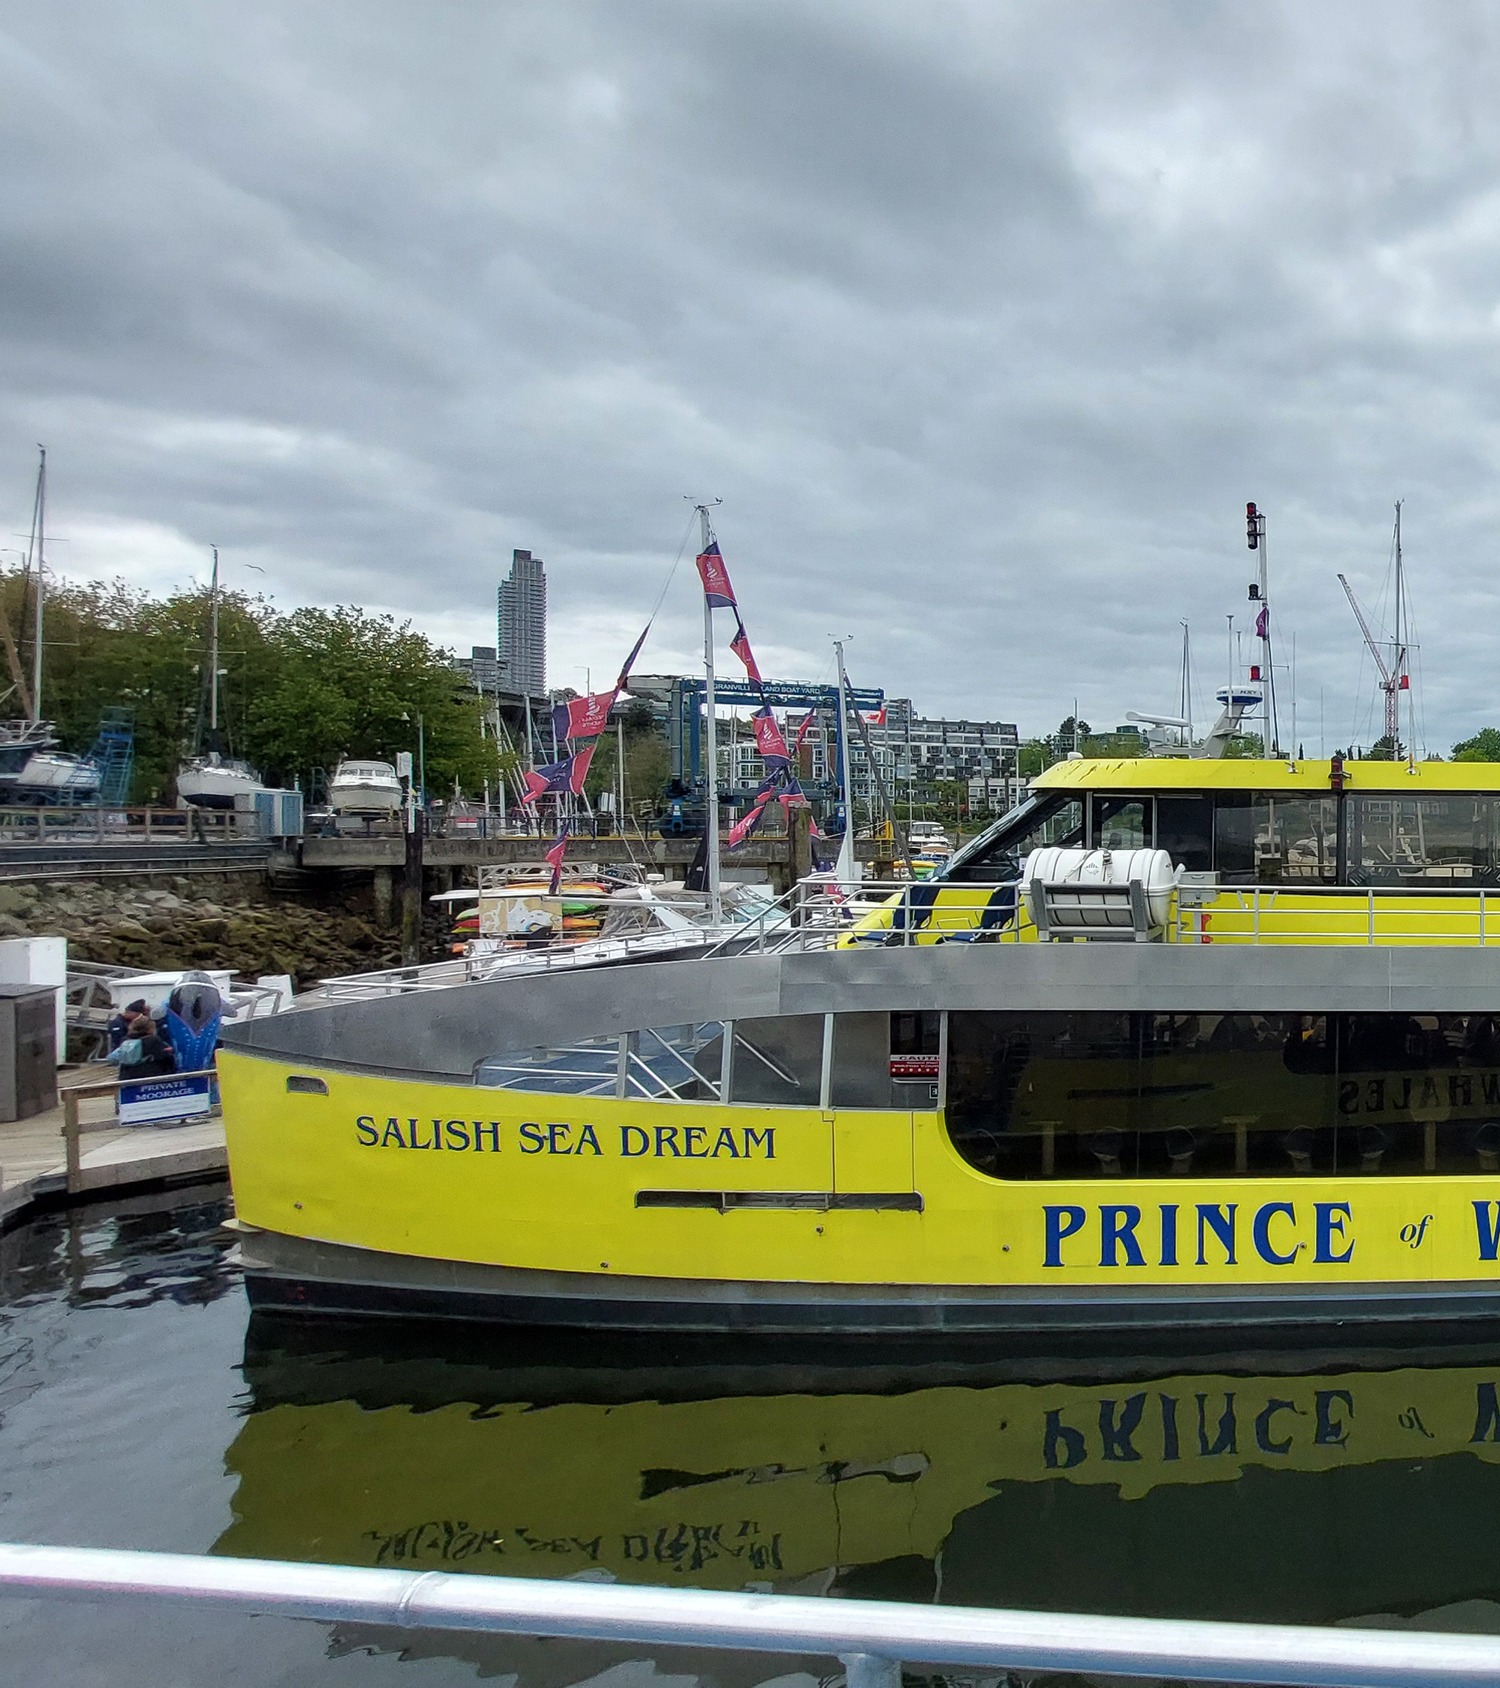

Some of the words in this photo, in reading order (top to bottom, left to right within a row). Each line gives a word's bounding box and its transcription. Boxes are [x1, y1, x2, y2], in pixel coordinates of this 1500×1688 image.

[135, 1087, 195, 1101] MOORAGE
[140, 1080, 188, 1092] PRIVATE
[355, 1115, 502, 1153] SALISH
[518, 1121, 604, 1156] SEA
[619, 1125, 777, 1159] DREAM
[1041, 1201, 1356, 1268] PRINCE
[1399, 1214, 1434, 1249] of
